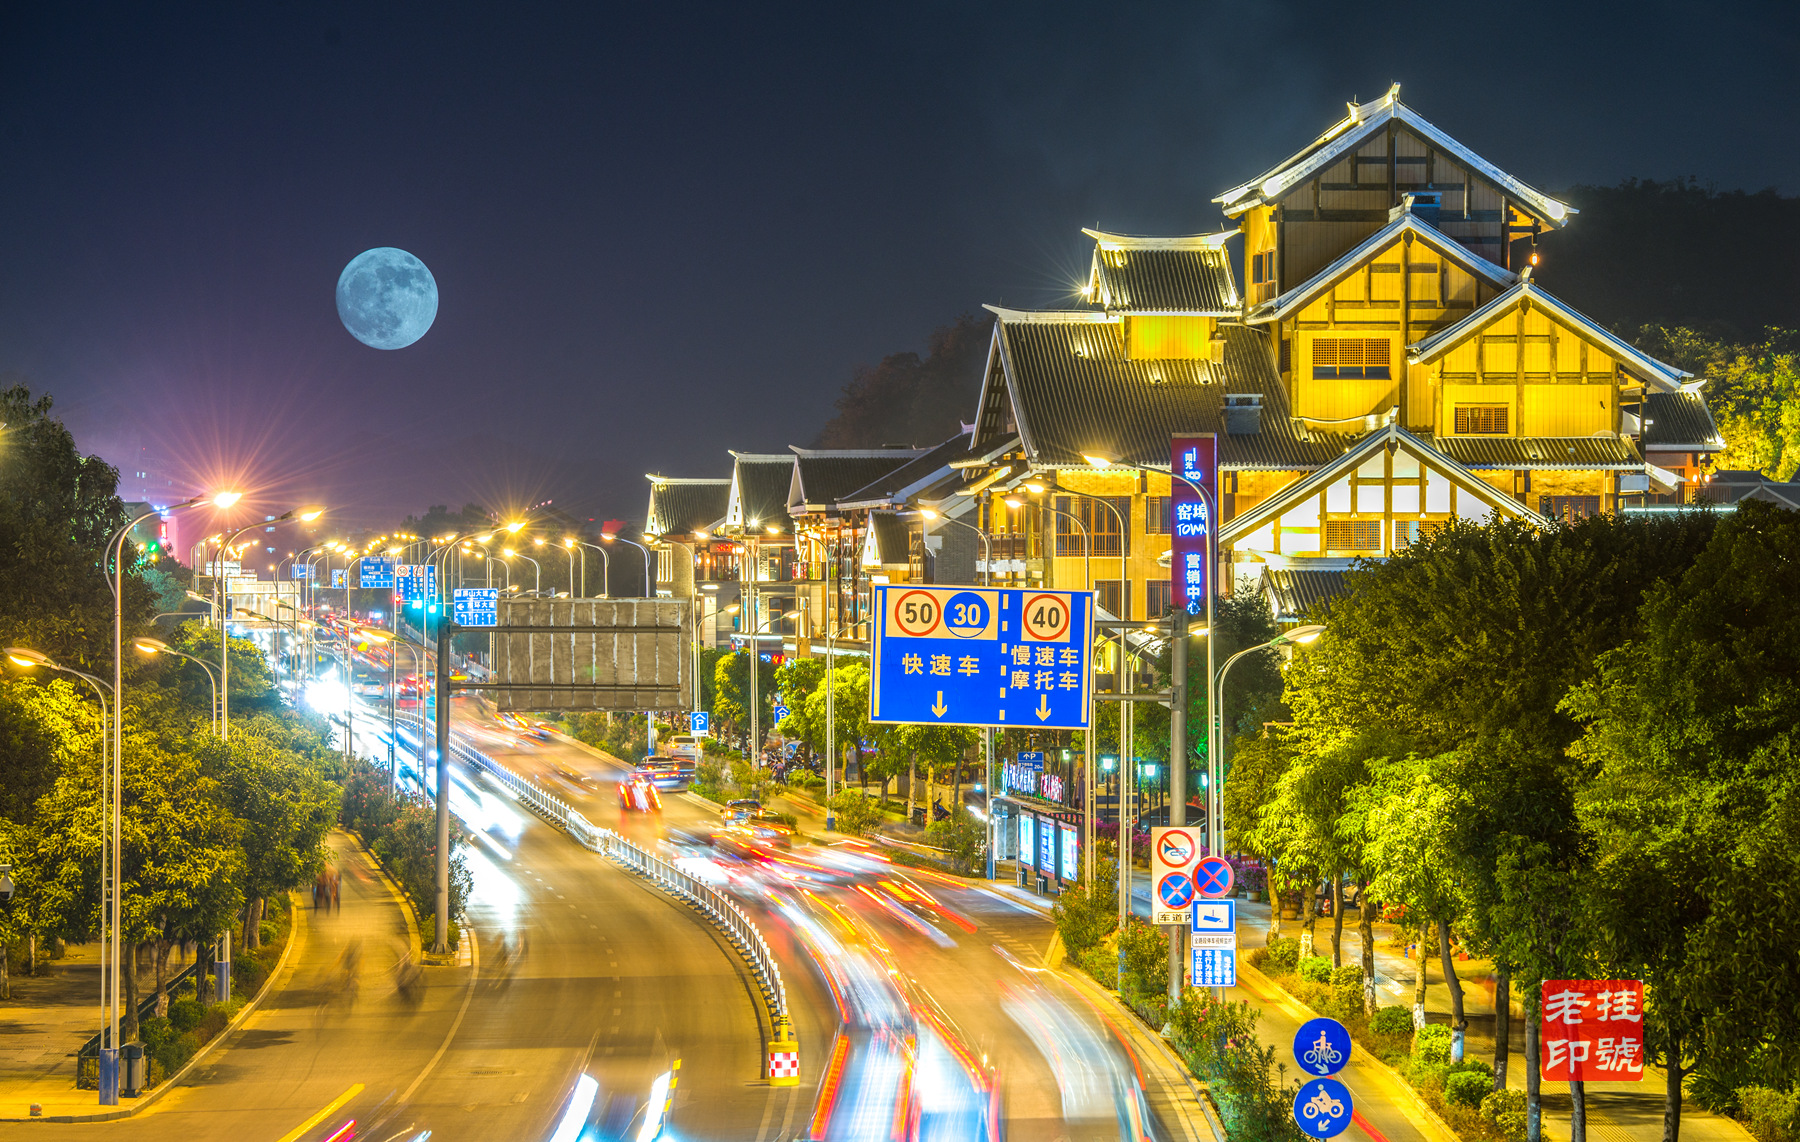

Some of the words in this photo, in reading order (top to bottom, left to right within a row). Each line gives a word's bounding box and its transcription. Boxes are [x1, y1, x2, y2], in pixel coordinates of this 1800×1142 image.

[462, 589, 488, 597] 屏山大道
[1186, 553, 1200, 615] 营销中心
[905, 602, 933, 624] 50
[953, 603, 981, 626] 30
[1032, 606, 1060, 629] 40
[902, 653, 980, 677] 快速车
[1010, 645, 1079, 668] 慢速车
[1010, 669, 1079, 691] 摩托车
